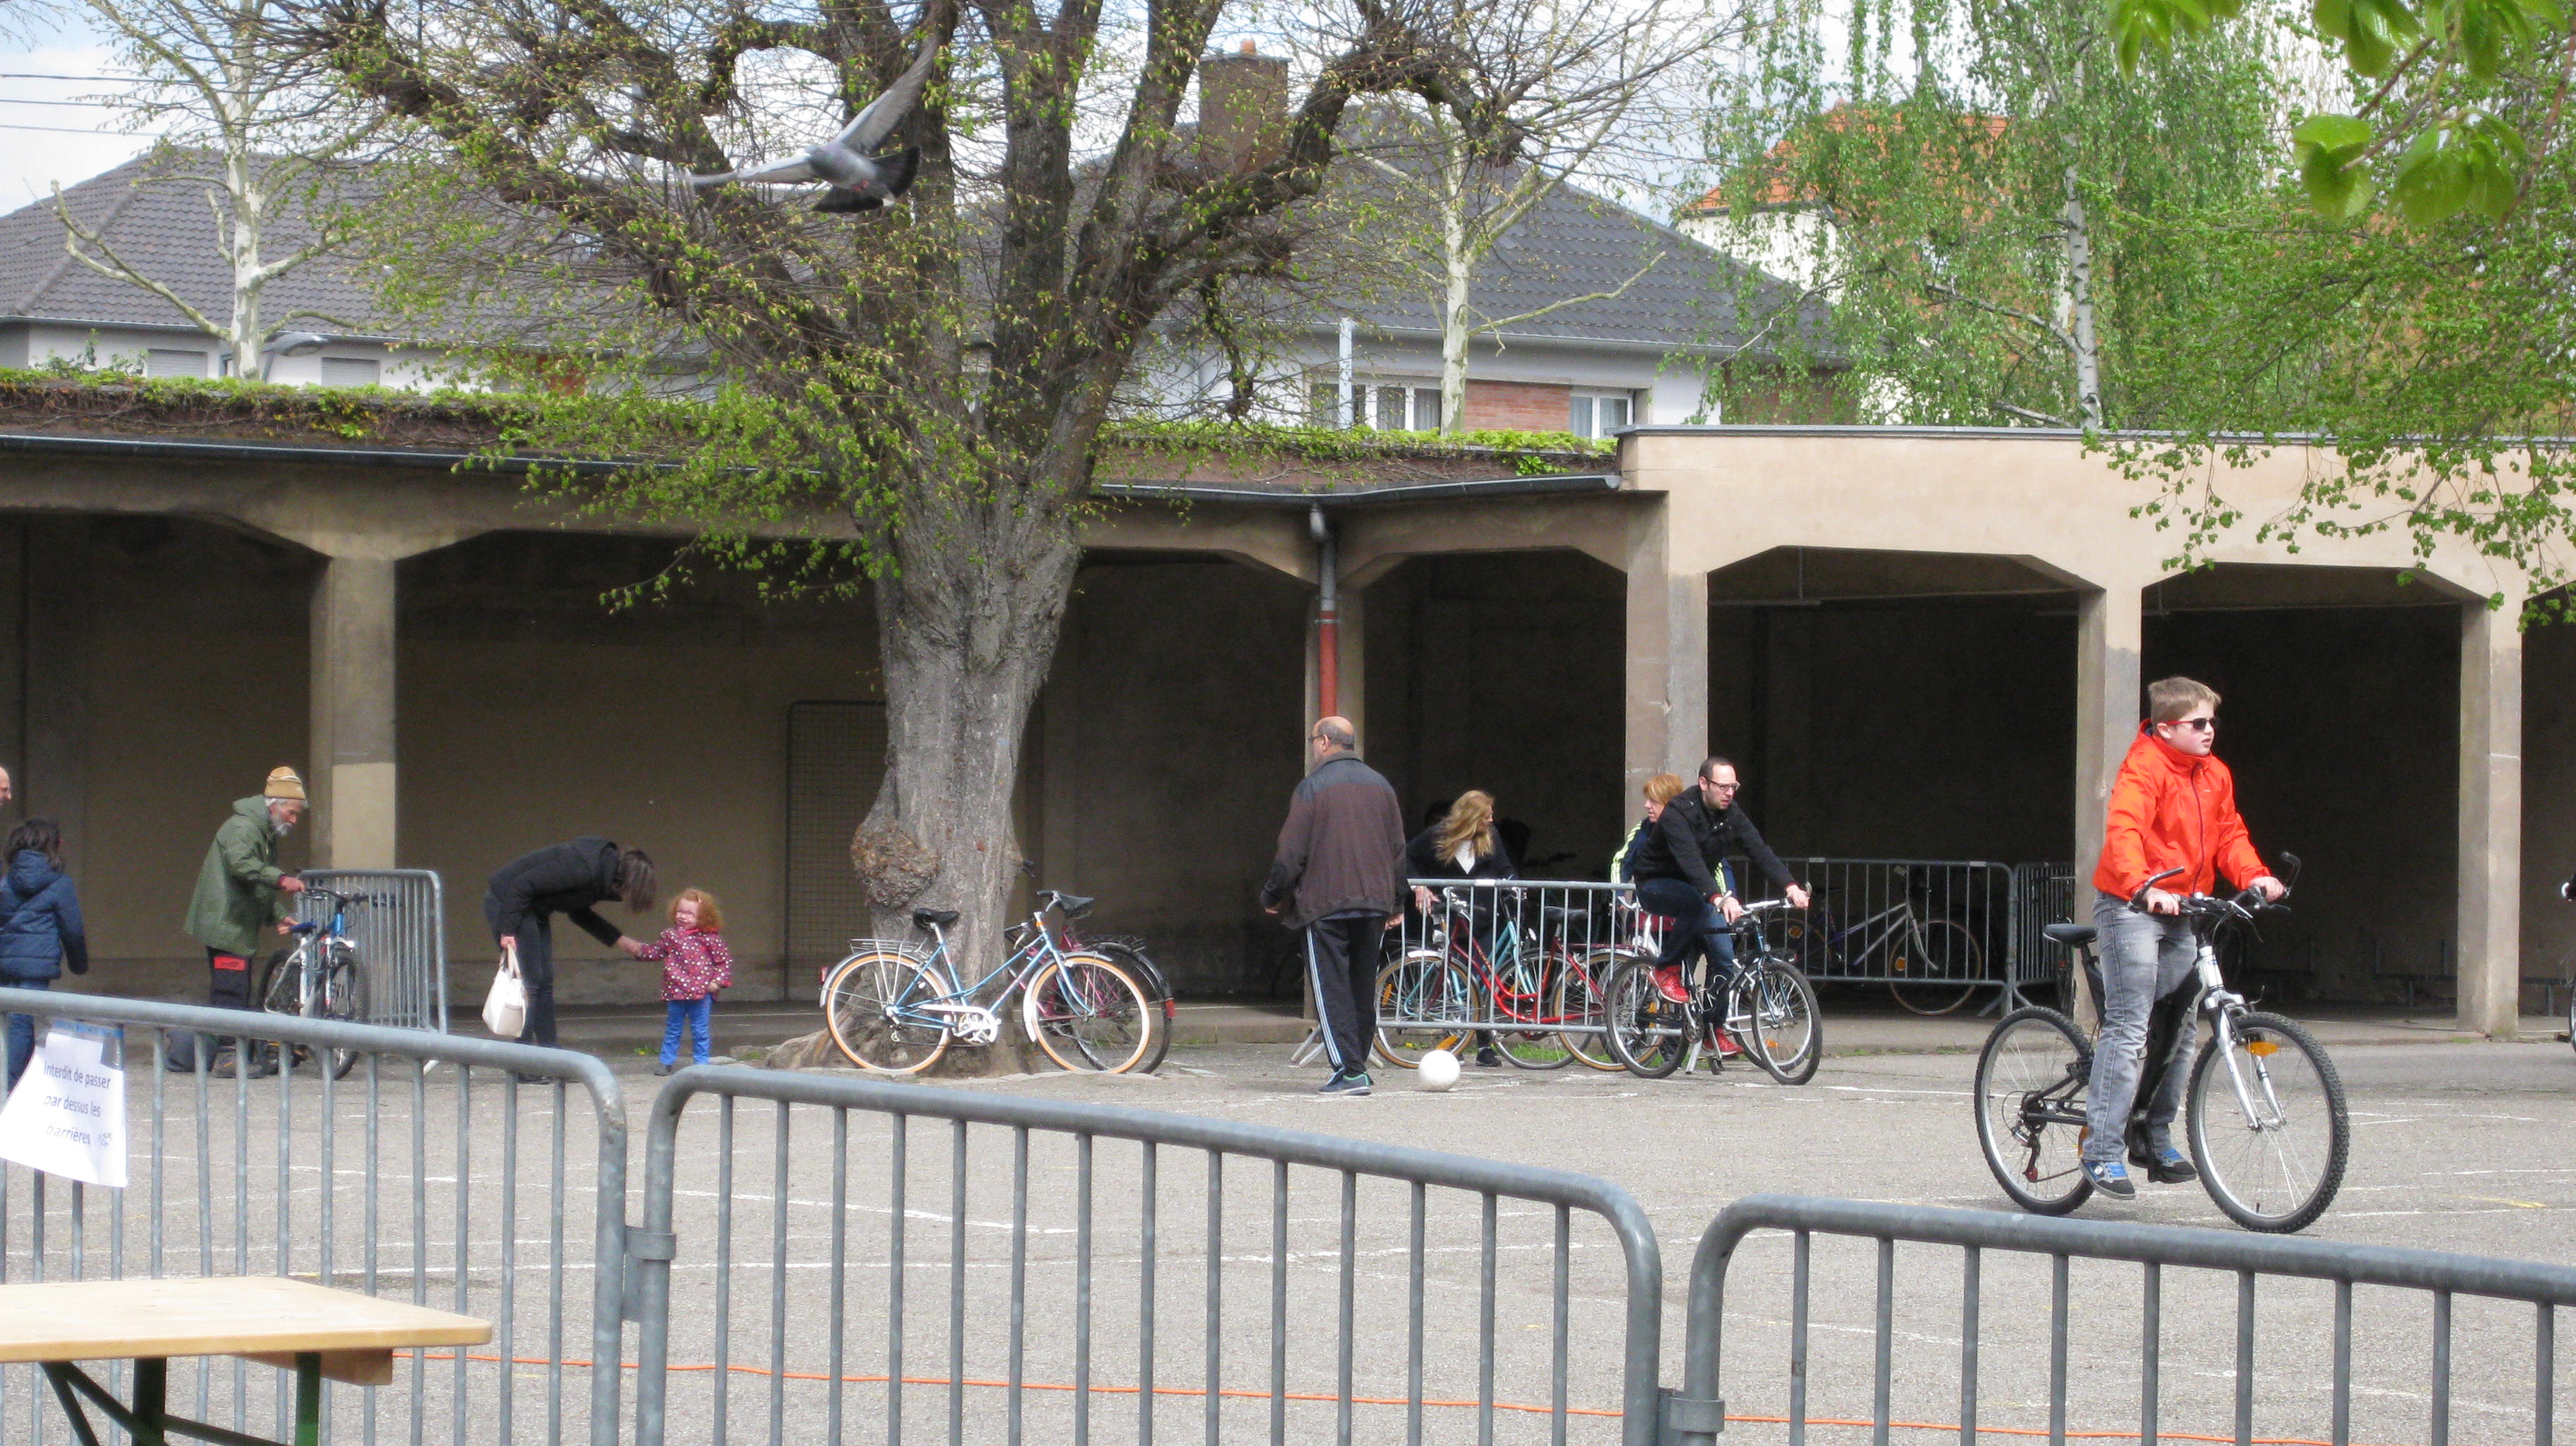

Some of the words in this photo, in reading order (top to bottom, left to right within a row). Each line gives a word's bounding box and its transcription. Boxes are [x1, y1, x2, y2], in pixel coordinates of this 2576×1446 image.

[73, 1067, 83, 1083] de
[85, 1073, 111, 1089] passer
[43, 1095, 62, 1108] par
[63, 1095, 89, 1114] dessus
[90, 1100, 101, 1117] les
[45, 1123, 91, 1145] barrières
